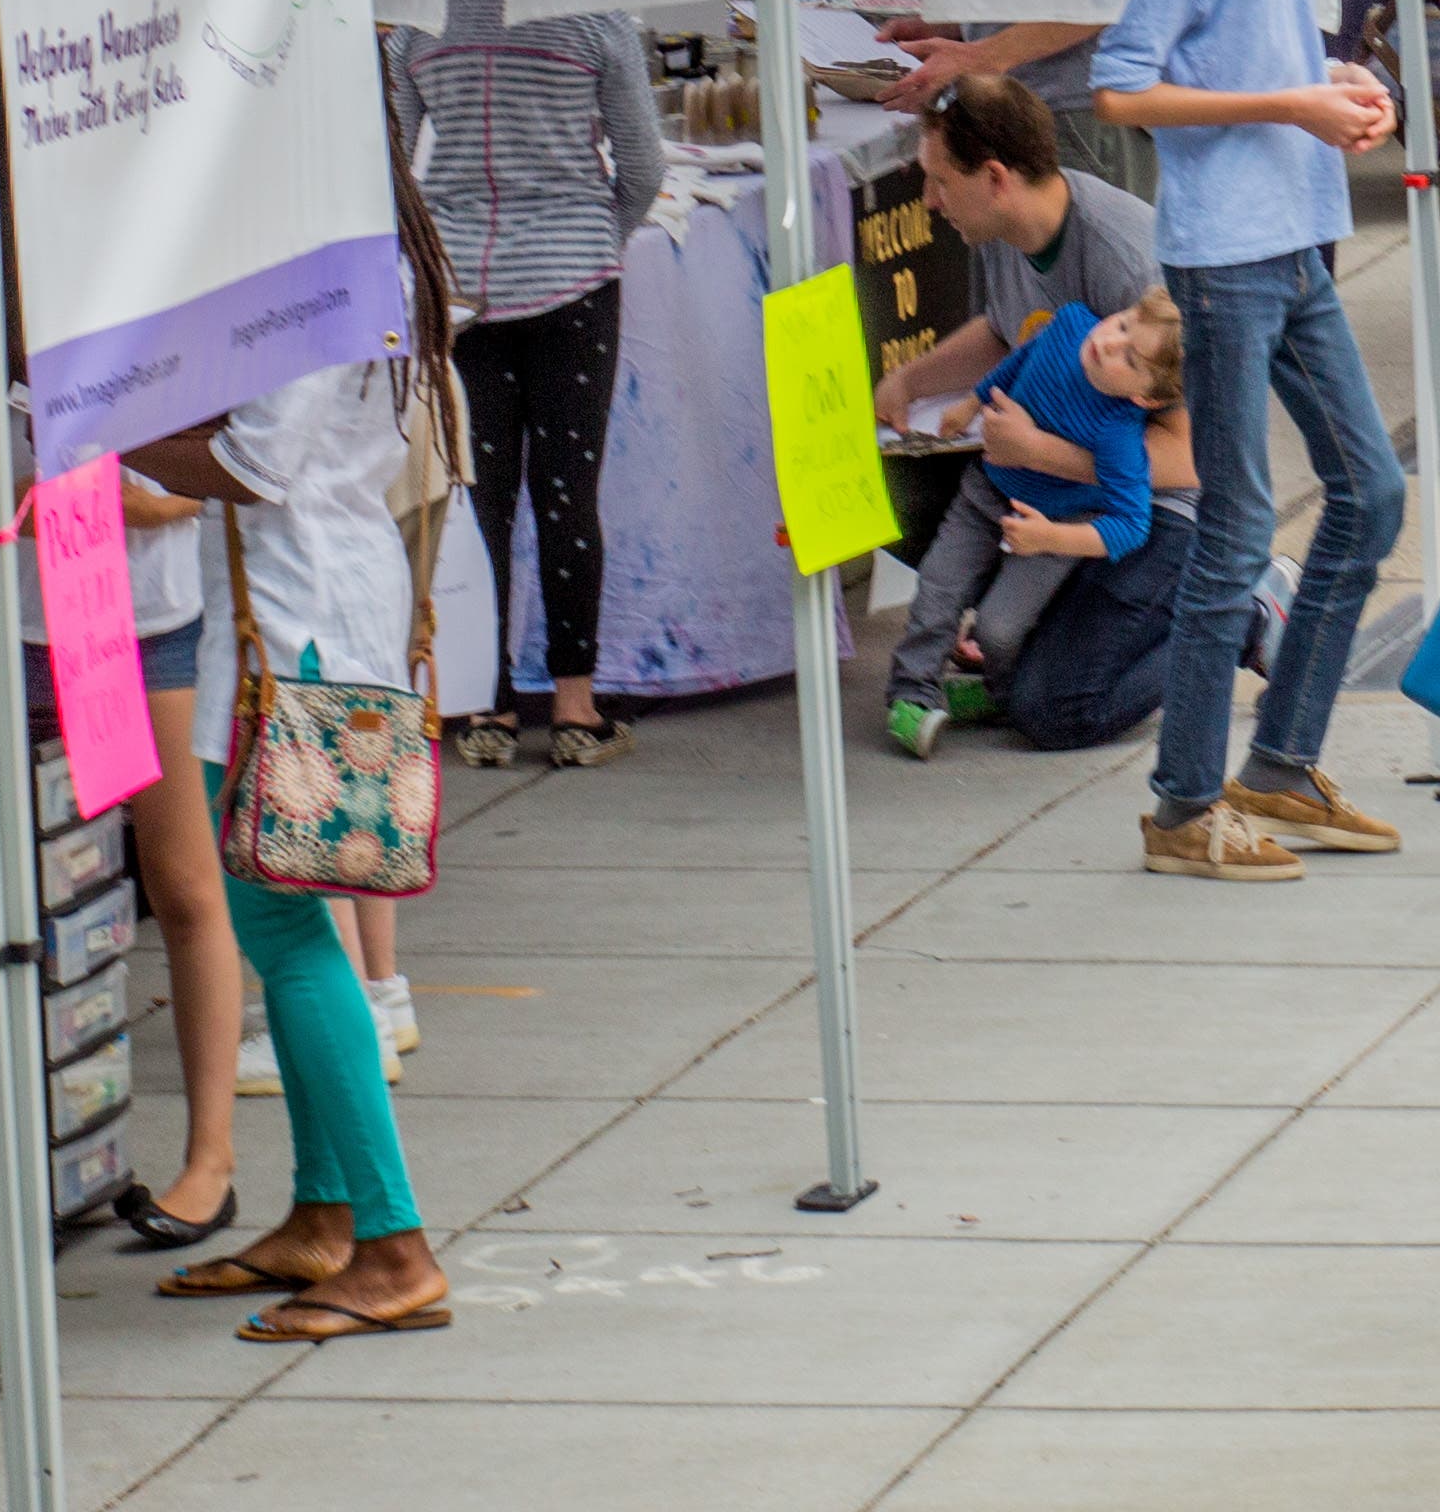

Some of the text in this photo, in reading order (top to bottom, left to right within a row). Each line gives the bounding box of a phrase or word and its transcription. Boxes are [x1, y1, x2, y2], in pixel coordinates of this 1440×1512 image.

[15, 25, 95, 92] Helping
[21, 104, 71, 149] Thrive
[74, 90, 109, 134] with
[112, 84, 153, 135] Every
[858, 199, 934, 262] WELCOME
[893, 267, 919, 321] TO
